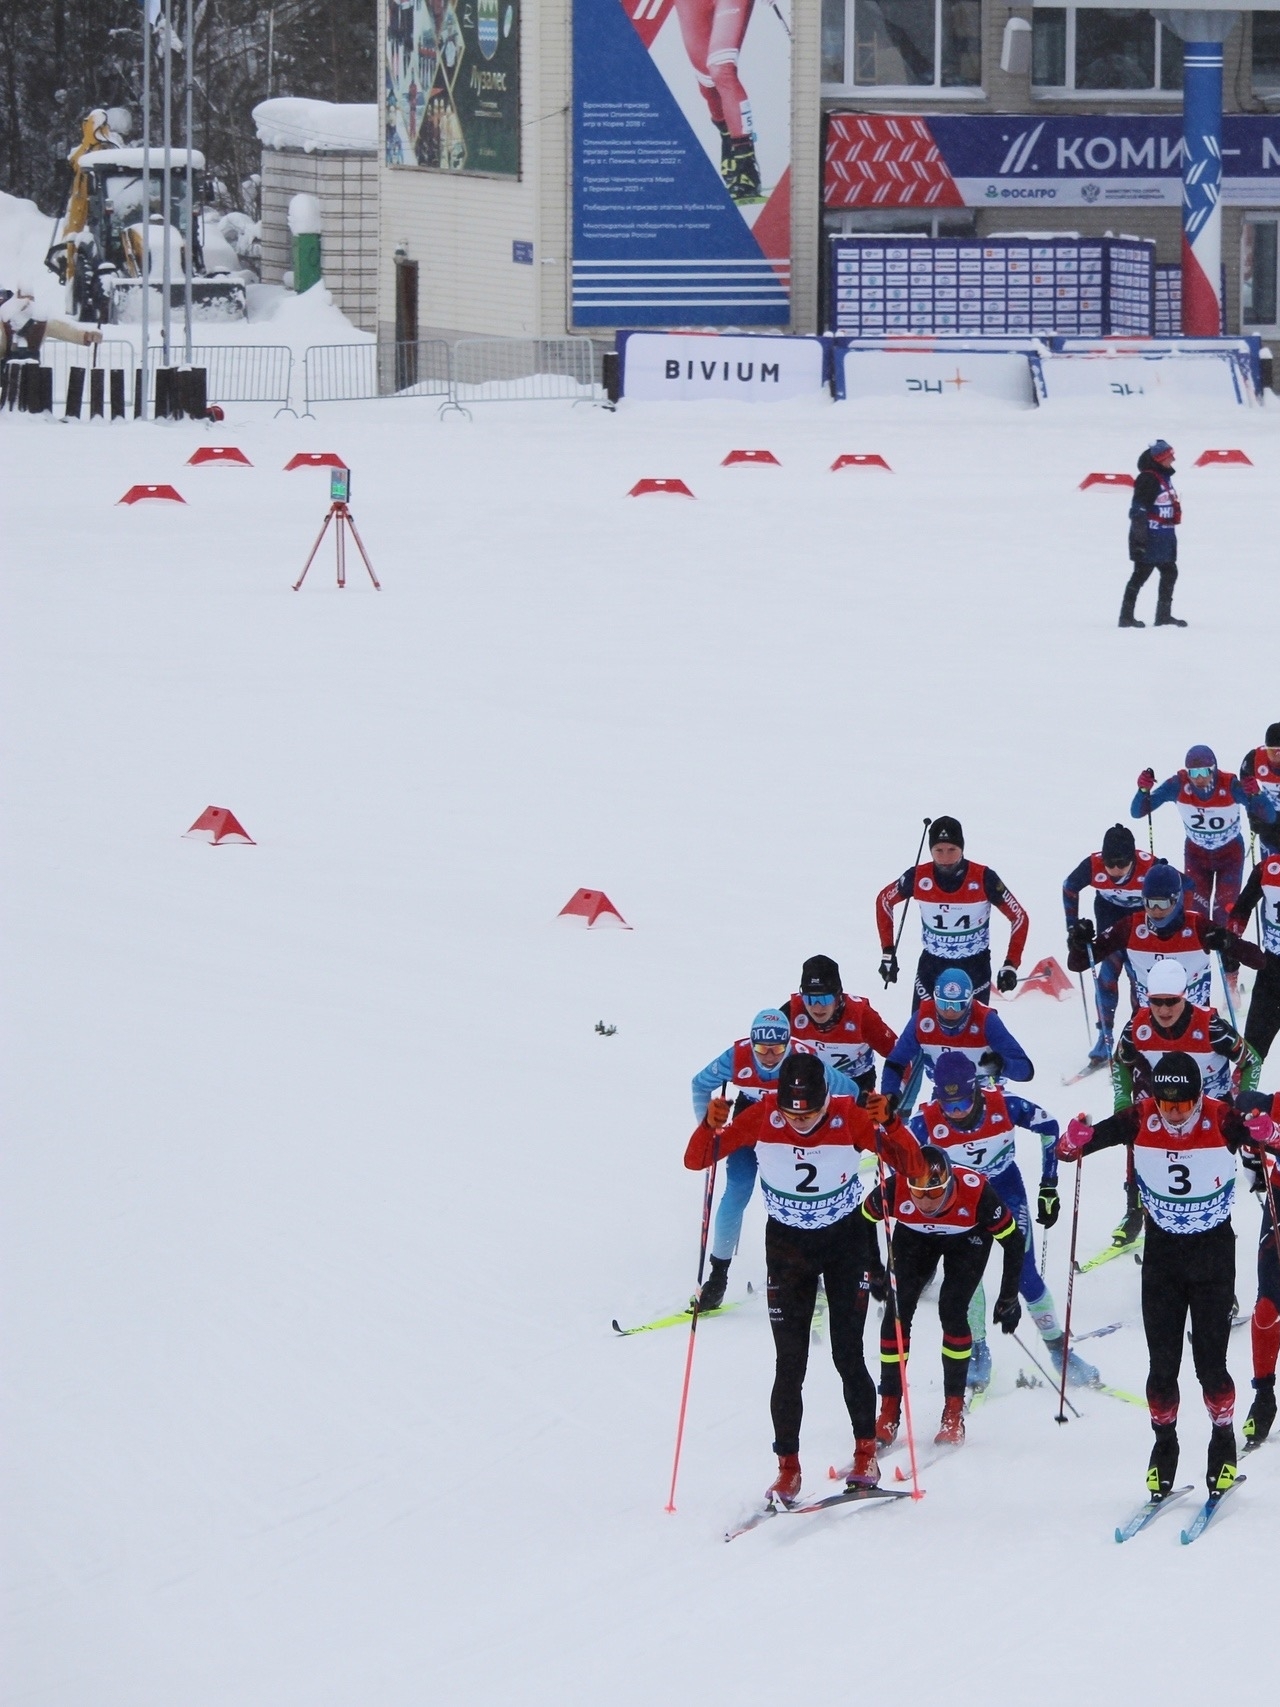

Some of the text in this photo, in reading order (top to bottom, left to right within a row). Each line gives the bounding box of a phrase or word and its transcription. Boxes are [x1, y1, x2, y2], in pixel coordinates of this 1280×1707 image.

[1057, 137, 1184, 169] КОМИ
[1001, 188, 1056, 199] ФОСАГРО
[665, 359, 779, 382] BIVIUM
[1190, 814, 1225, 830] 20
[933, 914, 970, 930] 14
[1154, 1075, 1189, 1083] LUKOIL
[795, 1162, 819, 1193] 2
[1168, 1164, 1221, 1196] 3 1
